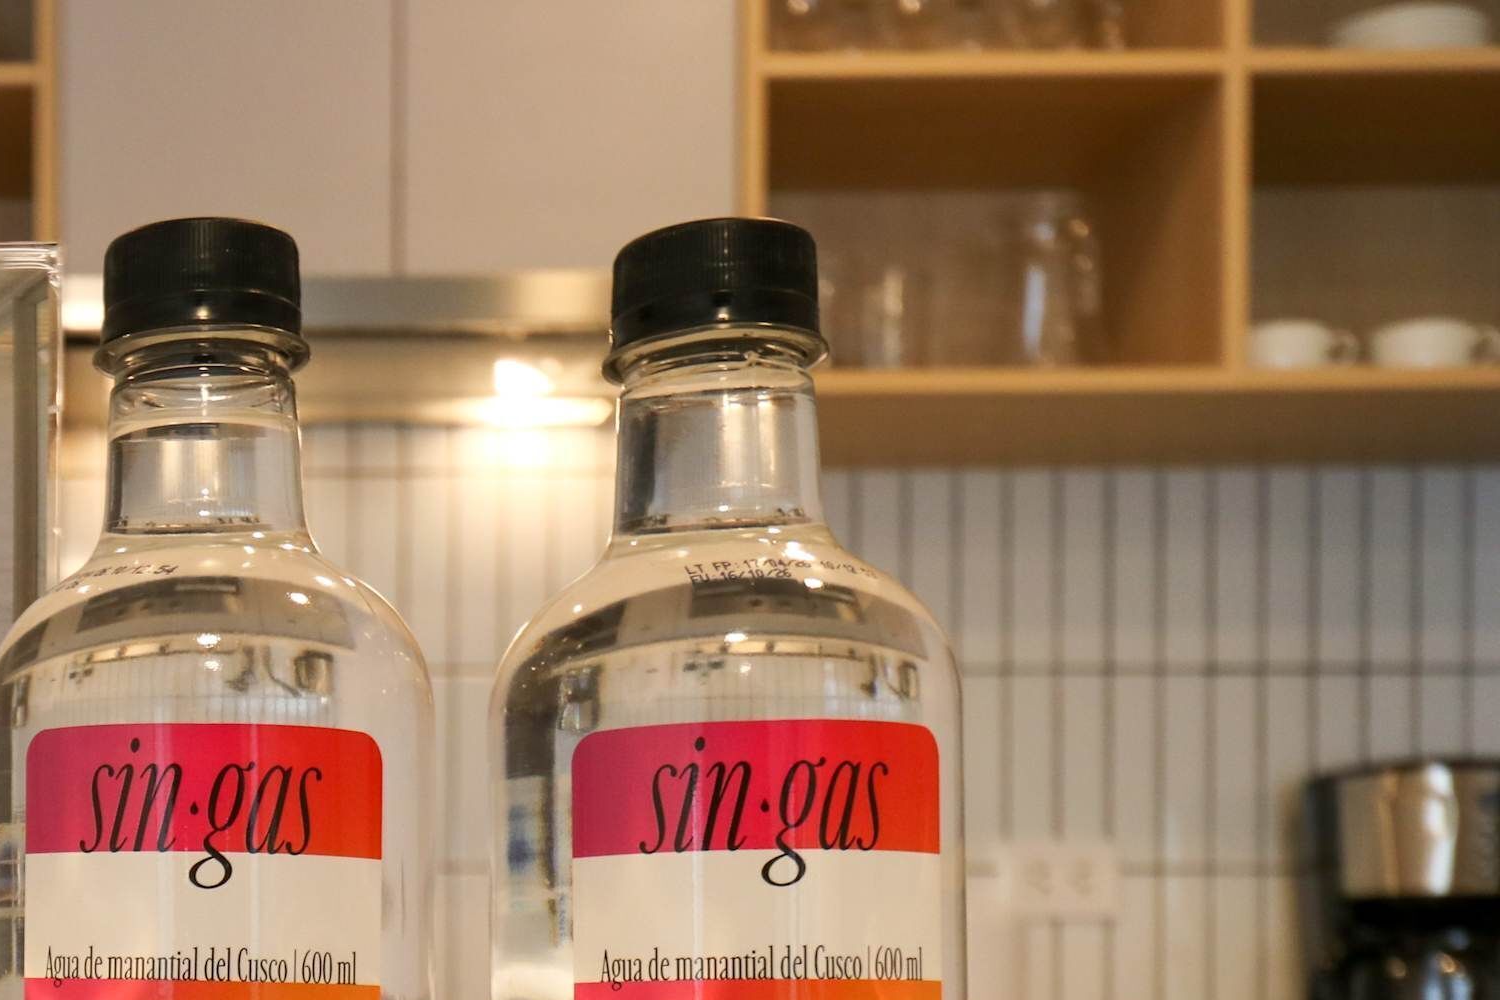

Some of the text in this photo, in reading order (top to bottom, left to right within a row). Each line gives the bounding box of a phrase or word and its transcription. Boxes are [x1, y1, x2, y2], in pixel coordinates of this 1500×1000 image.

[45, 945, 79, 988] Agua
[84, 946, 103, 981] de
[108, 946, 198, 982] manantial
[204, 947, 231, 983] del
[238, 947, 288, 984] Cusco
[302, 949, 333, 985] 600
[338, 951, 357, 986] ml
[600, 948, 643, 991] Agua
[649, 946, 670, 982] de
[676, 945, 773, 982] manantial
[780, 944, 808, 981] del
[814, 944, 863, 981] Cusco
[875, 945, 902, 982] 600
[906, 946, 923, 982] ml
